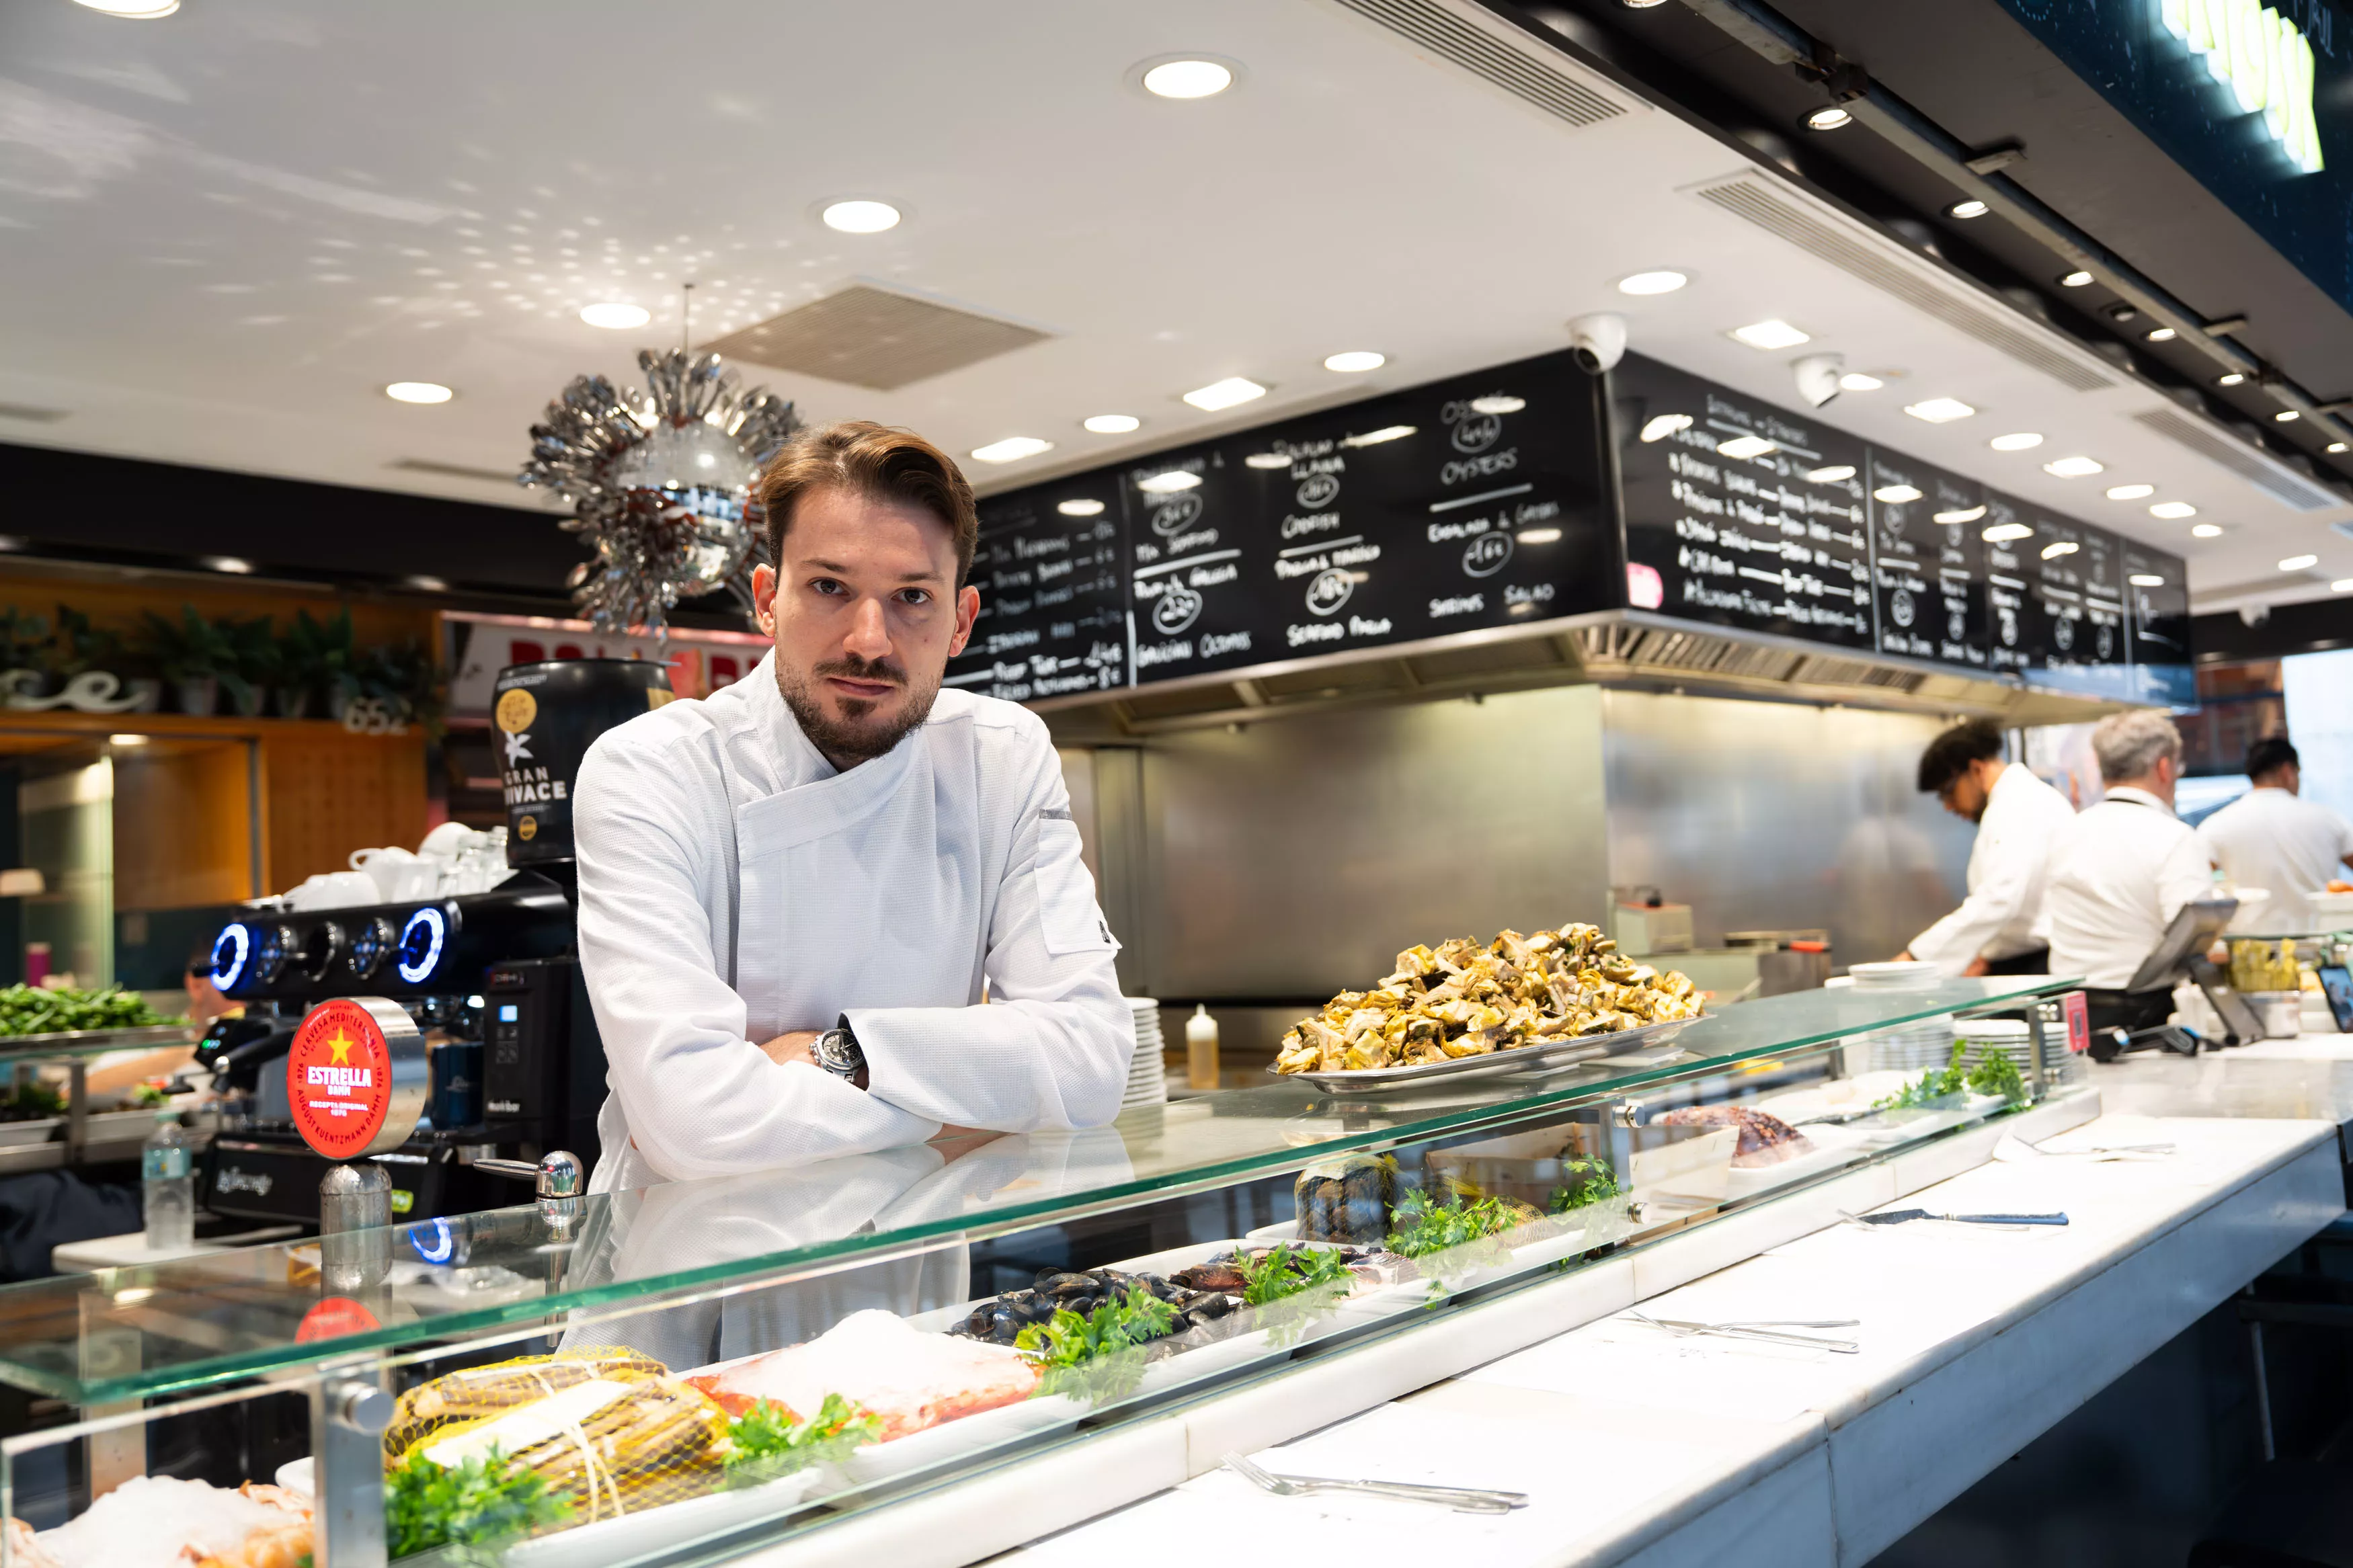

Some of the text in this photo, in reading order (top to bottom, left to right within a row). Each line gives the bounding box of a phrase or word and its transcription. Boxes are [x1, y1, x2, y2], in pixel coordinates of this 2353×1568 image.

[1441, 446, 1518, 485] OYSTERS
[1281, 511, 1341, 538] CODFISH
[1503, 583, 1555, 605] SALAD
[1285, 622, 1345, 648] SEAFOOD
[506, 767, 549, 786] GRAN
[301, 1018, 328, 1057] CERVESA
[307, 1066, 372, 1087] ESTRELLA
[327, 1084, 351, 1096] DAMM
[297, 1089, 383, 1145] AUGUST KUENTZMANN DAMM
[338, 1102, 369, 1112] ORIGINAL
